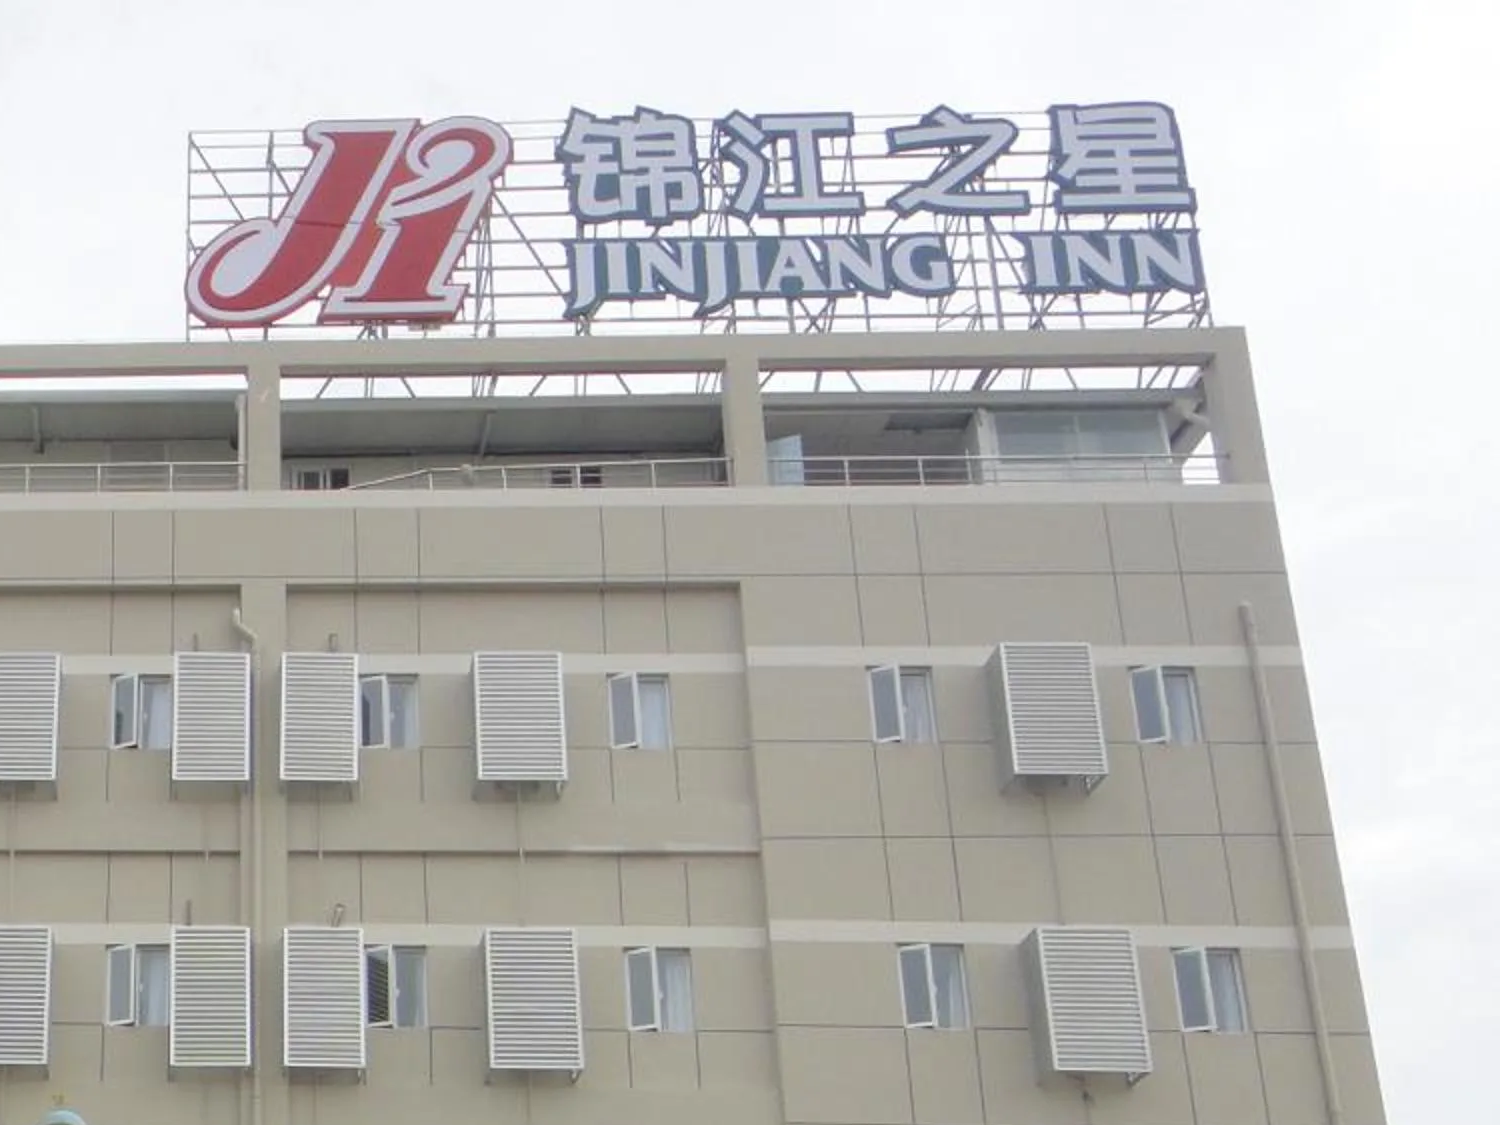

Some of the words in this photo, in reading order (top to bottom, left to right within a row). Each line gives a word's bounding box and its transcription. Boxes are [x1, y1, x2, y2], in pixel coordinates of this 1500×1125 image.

[562, 101, 1197, 223] 锦江之星
[563, 234, 957, 315] JINJIANG
[1022, 229, 1203, 297] INN
